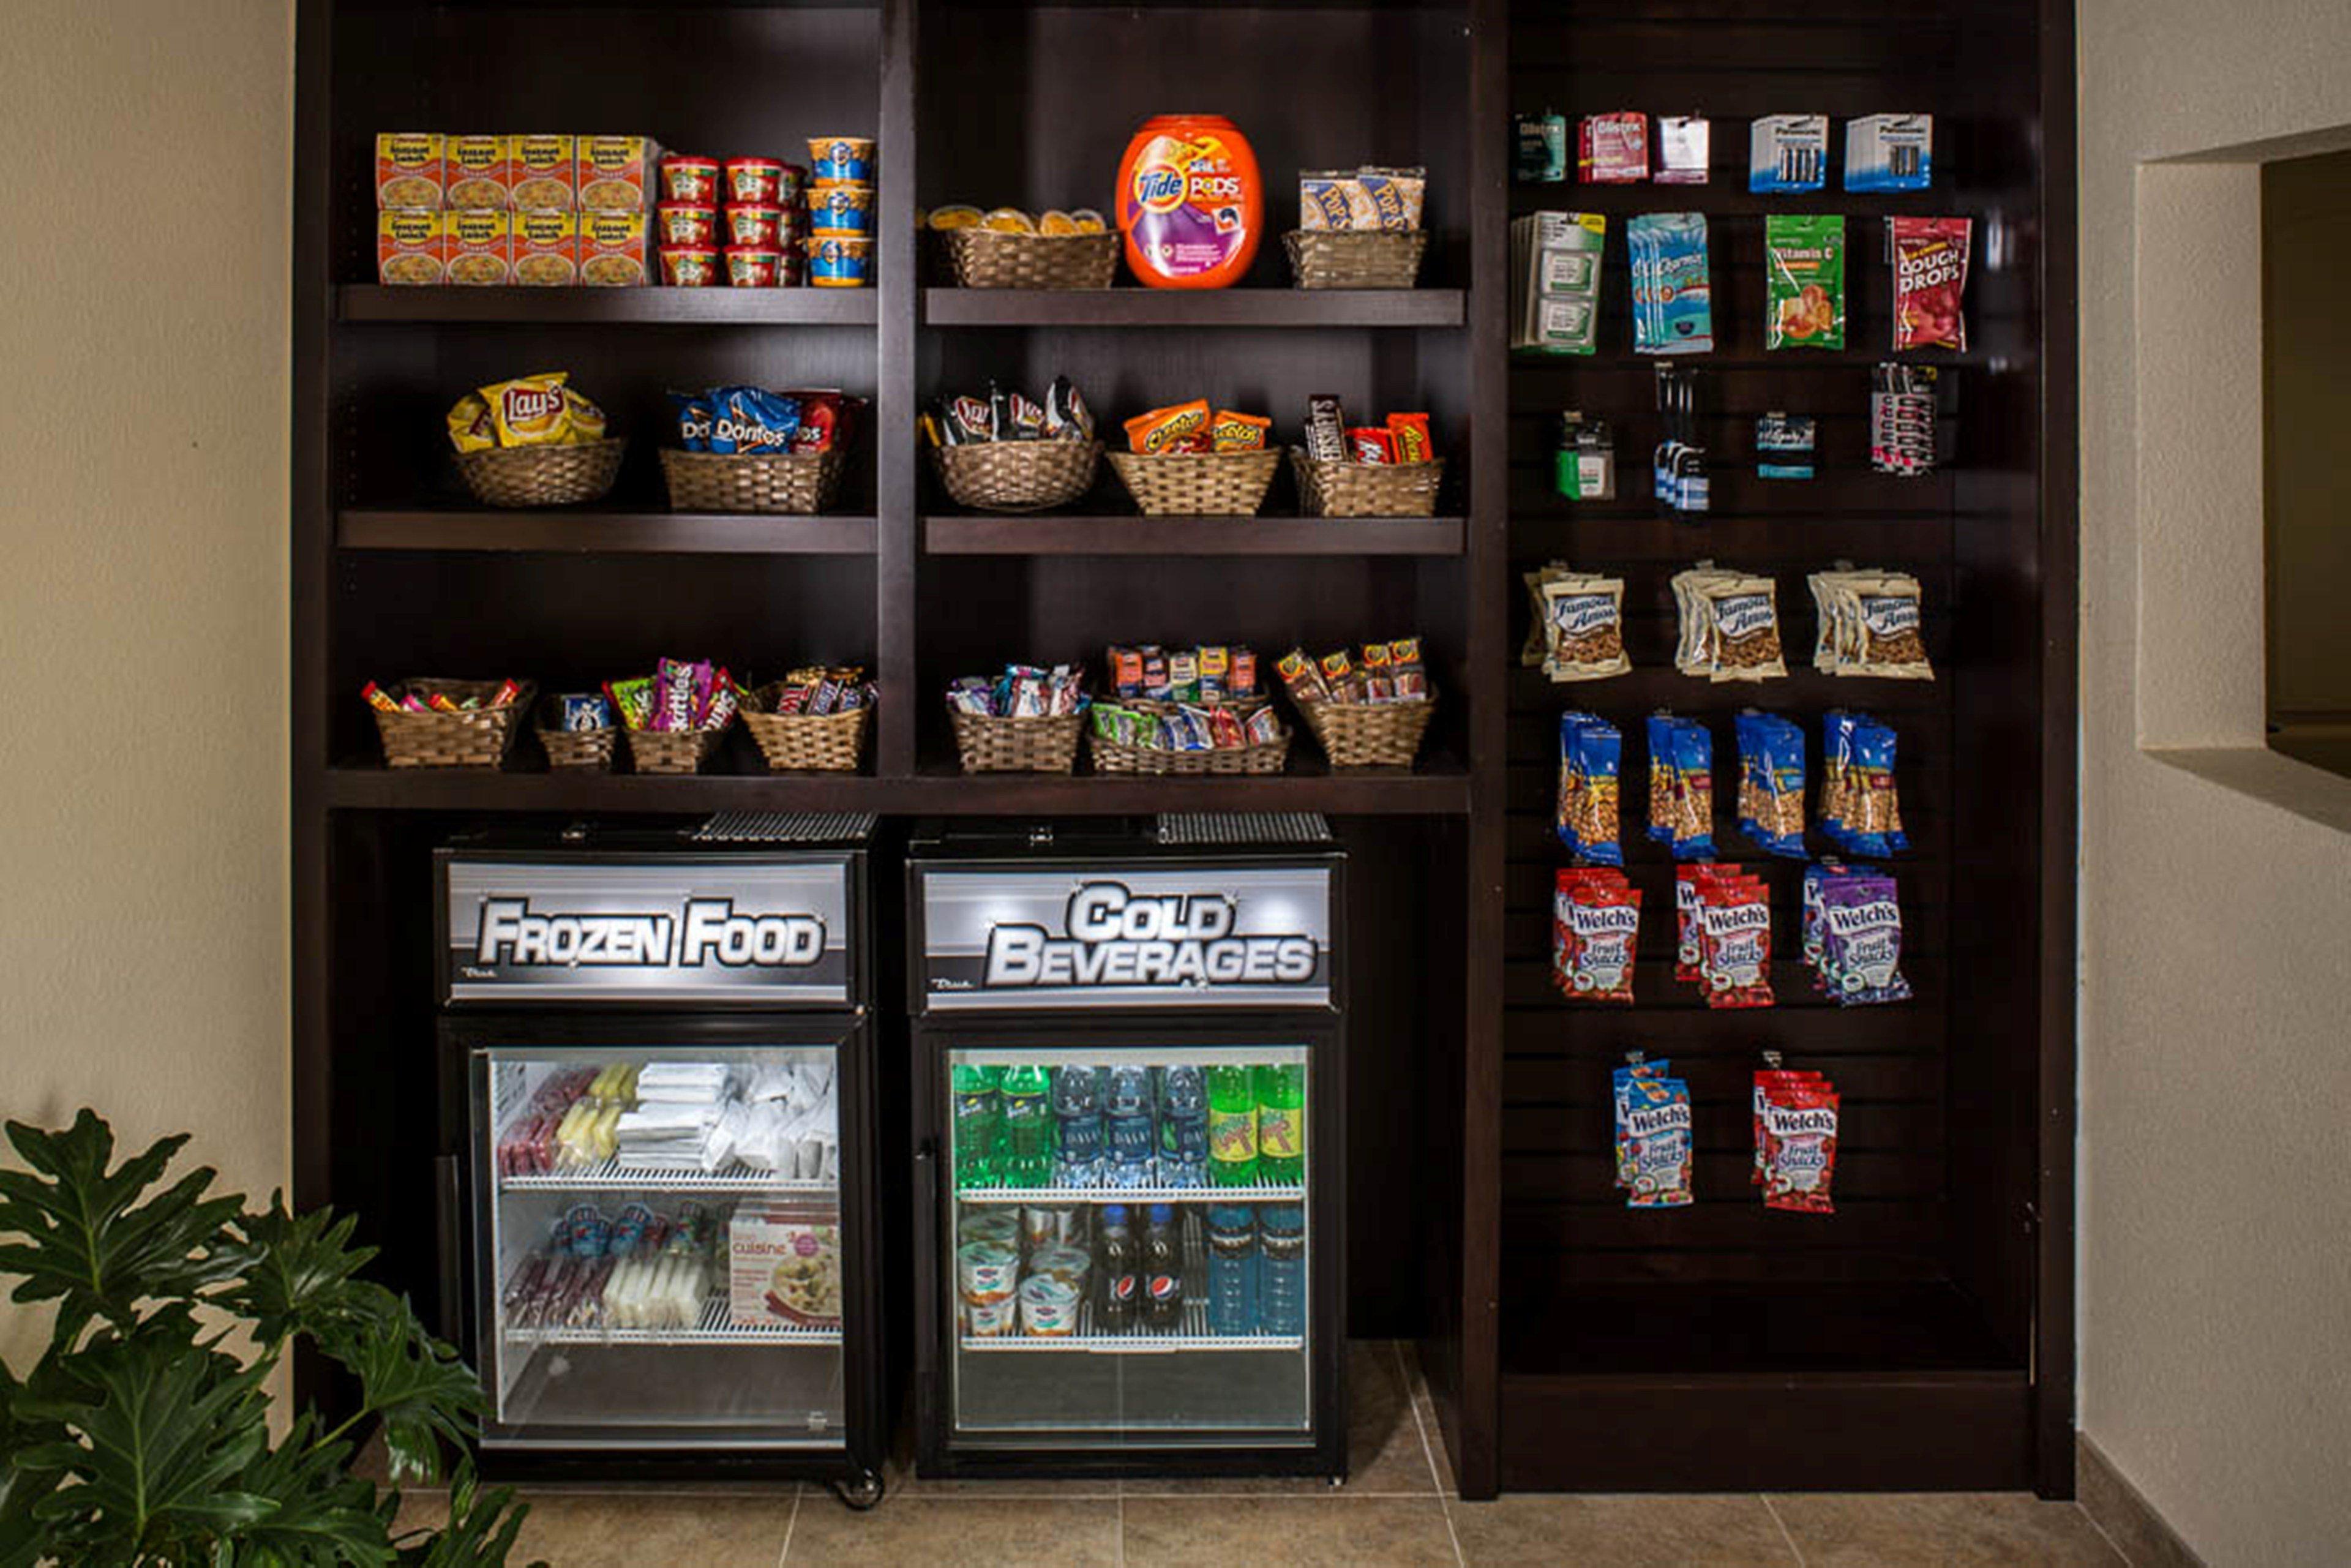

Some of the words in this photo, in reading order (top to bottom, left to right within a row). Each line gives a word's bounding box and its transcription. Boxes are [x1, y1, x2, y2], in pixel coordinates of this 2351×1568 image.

[1139, 171, 1183, 203] Tide
[1190, 176, 1241, 195] PODS
[1899, 264, 1959, 293] DROPS
[508, 383, 560, 422] Lay's
[716, 419, 786, 447] Doritos
[1316, 399, 1343, 462] ERSHEY'S
[670, 664, 693, 733] kittles
[1067, 881, 1235, 942] COLD
[1577, 909, 1636, 929] Welch's
[1709, 907, 1767, 931] Welch's
[1834, 904, 1897, 929] Welch's
[984, 923, 1318, 986] BEVERAGES
[1633, 1106, 1690, 1131] Welch's
[1772, 1112, 1834, 1131] Welch's
[733, 1242, 787, 1255] cuisine
